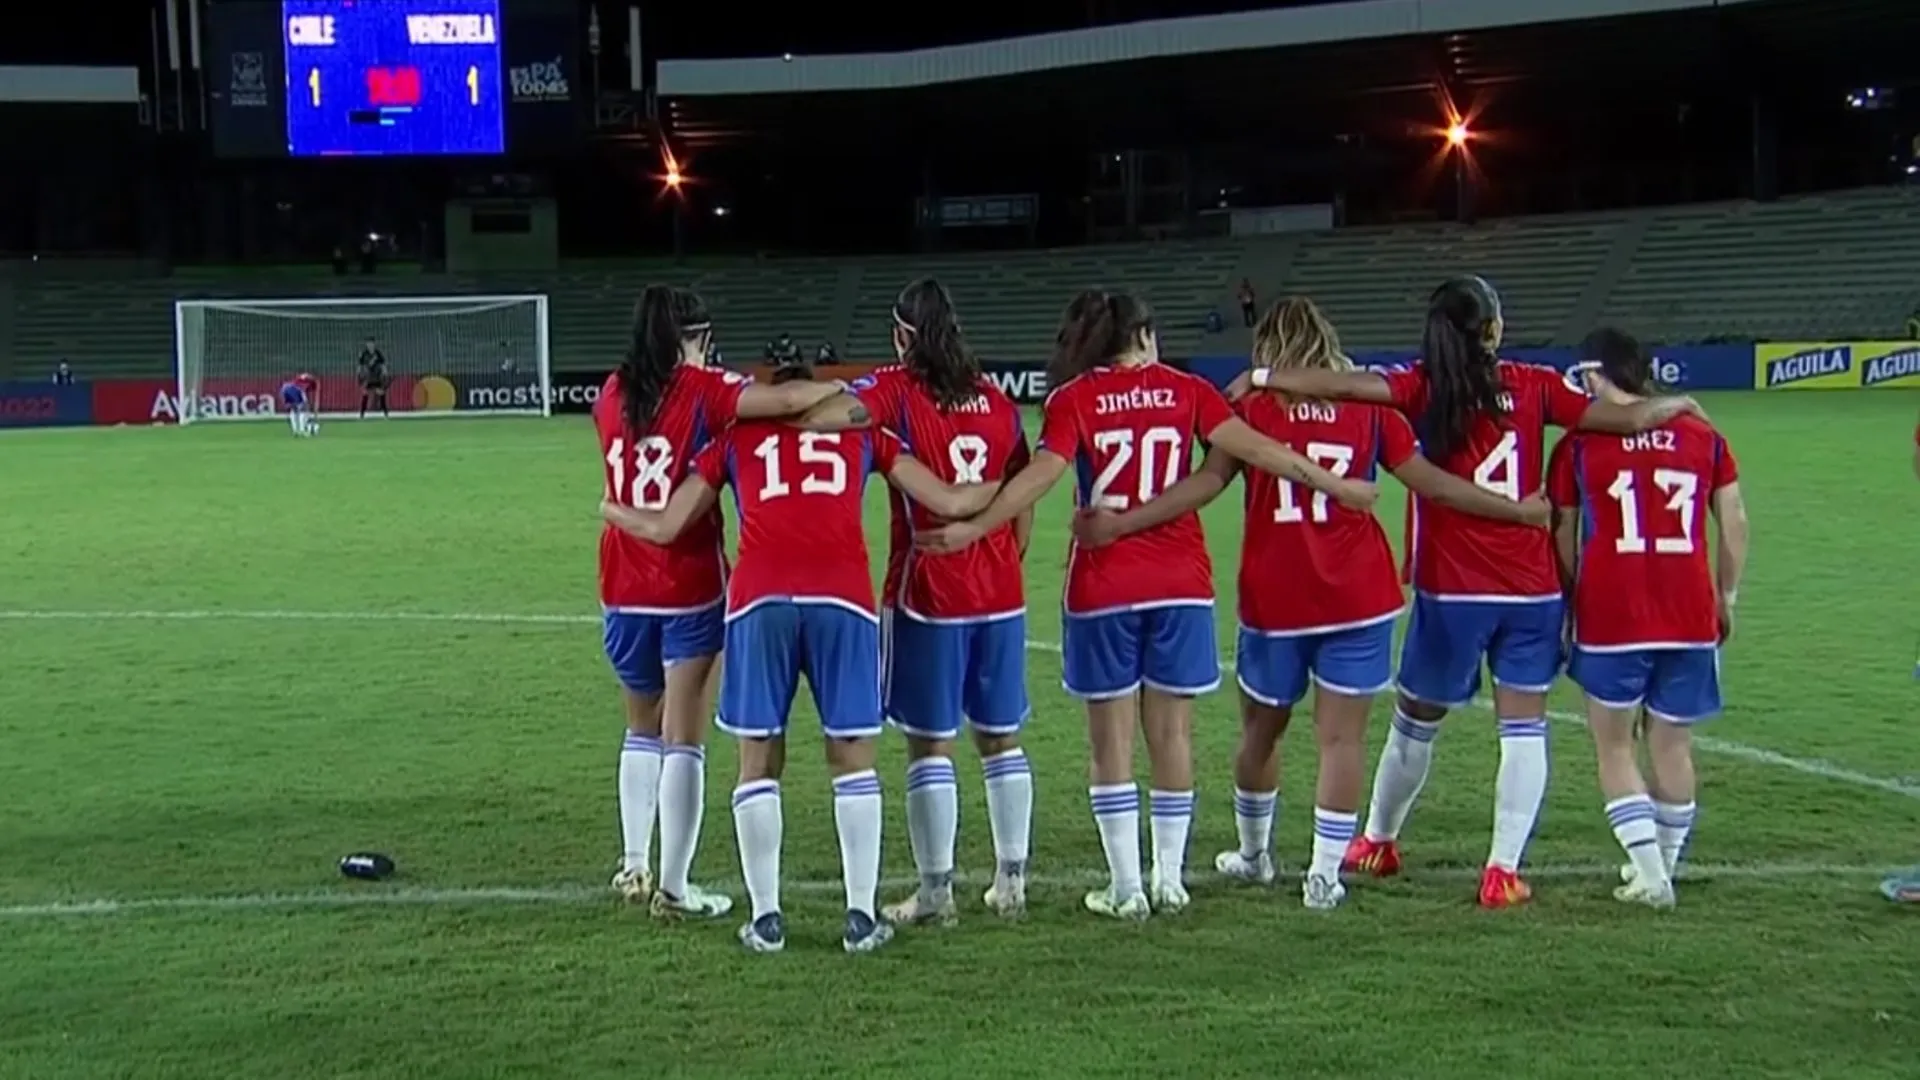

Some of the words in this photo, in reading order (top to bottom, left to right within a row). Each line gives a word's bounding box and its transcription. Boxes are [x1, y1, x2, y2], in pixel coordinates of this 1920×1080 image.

[308, 66, 320, 108] 1
[466, 64, 479, 106] 1
[990, 371, 1047, 399] WE
[1770, 349, 1846, 384] AGUILA
[1866, 350, 1920, 384] AGUI
[0, 397, 55, 419] 022
[151, 388, 276, 419] Avianca
[469, 382, 600, 406] mastrca
[606, 436, 674, 510] 18
[754, 431, 847, 501] 15
[949, 434, 988, 484] 8
[1090, 426, 1182, 510] 20
[1274, 441, 1353, 522] 17
[1474, 431, 1519, 502] 4
[1607, 468, 1698, 554] 13
